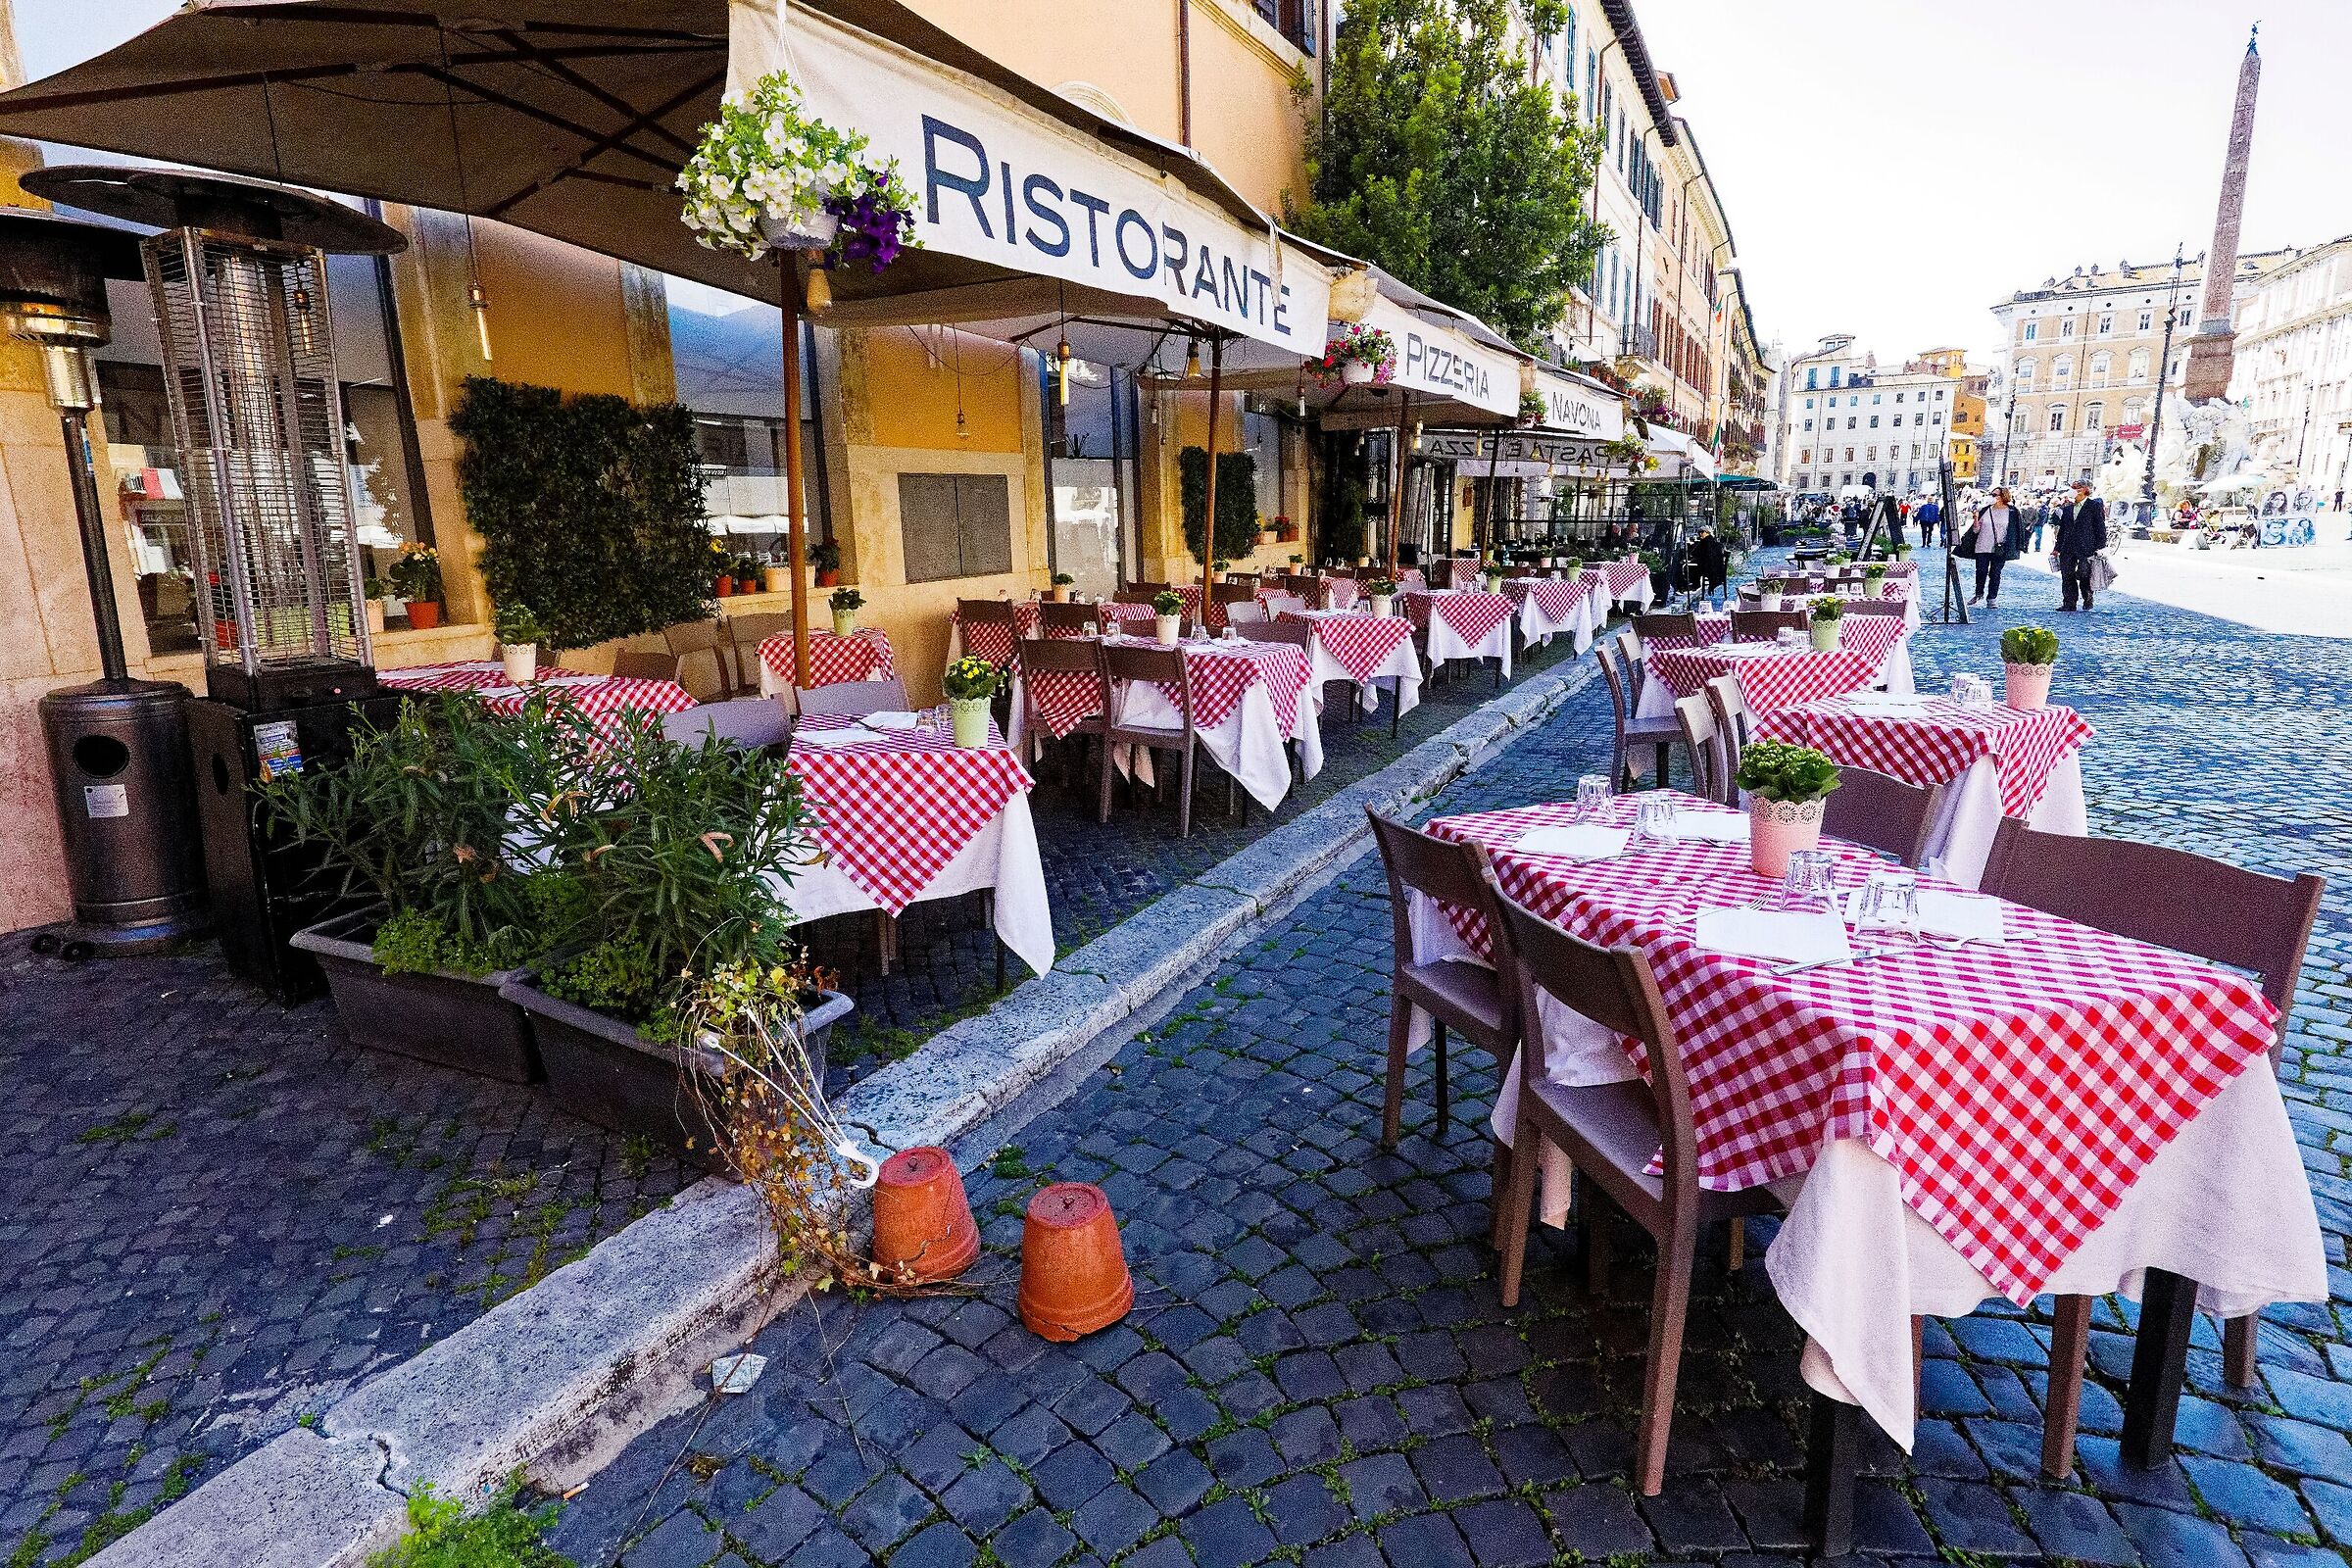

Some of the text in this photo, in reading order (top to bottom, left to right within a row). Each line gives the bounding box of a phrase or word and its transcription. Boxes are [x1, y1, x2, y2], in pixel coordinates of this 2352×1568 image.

[921, 113, 1292, 336] RISTORANTE
[1406, 332, 1490, 400] PIZZERIA
[1552, 391, 1601, 431] NAVONA
